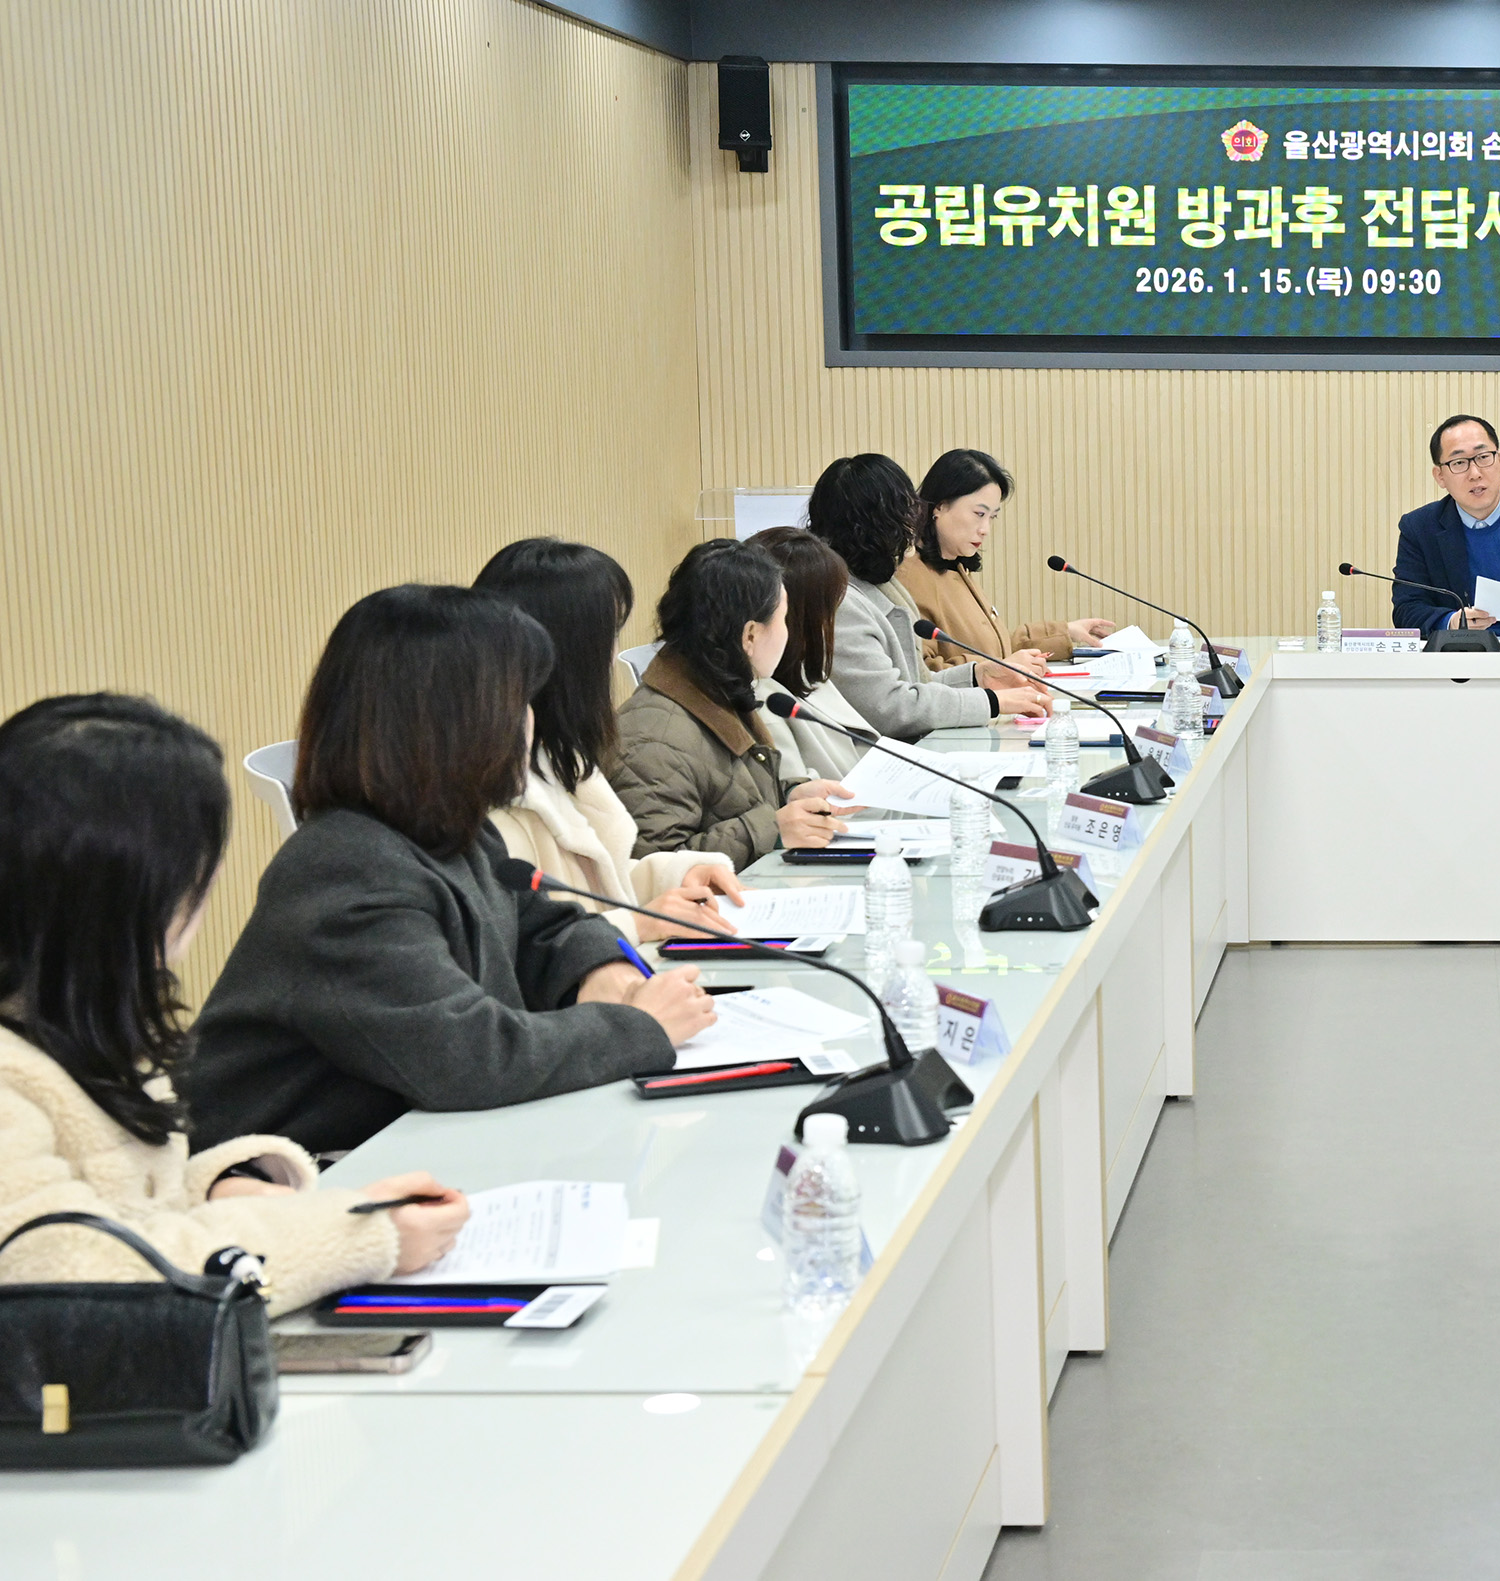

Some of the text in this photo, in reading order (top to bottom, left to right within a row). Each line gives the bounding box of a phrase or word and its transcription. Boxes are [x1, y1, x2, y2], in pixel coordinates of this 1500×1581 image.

[1233, 136, 1256, 147] 의회
[1282, 130, 1473, 161] 울산광역시의회
[874, 183, 1157, 247] 공립유치원
[1177, 185, 1346, 249] 방과후
[1135, 266, 1441, 297] 2026. 1. 15.(목) 09:30
[1085, 818, 1123, 843] 조은영
